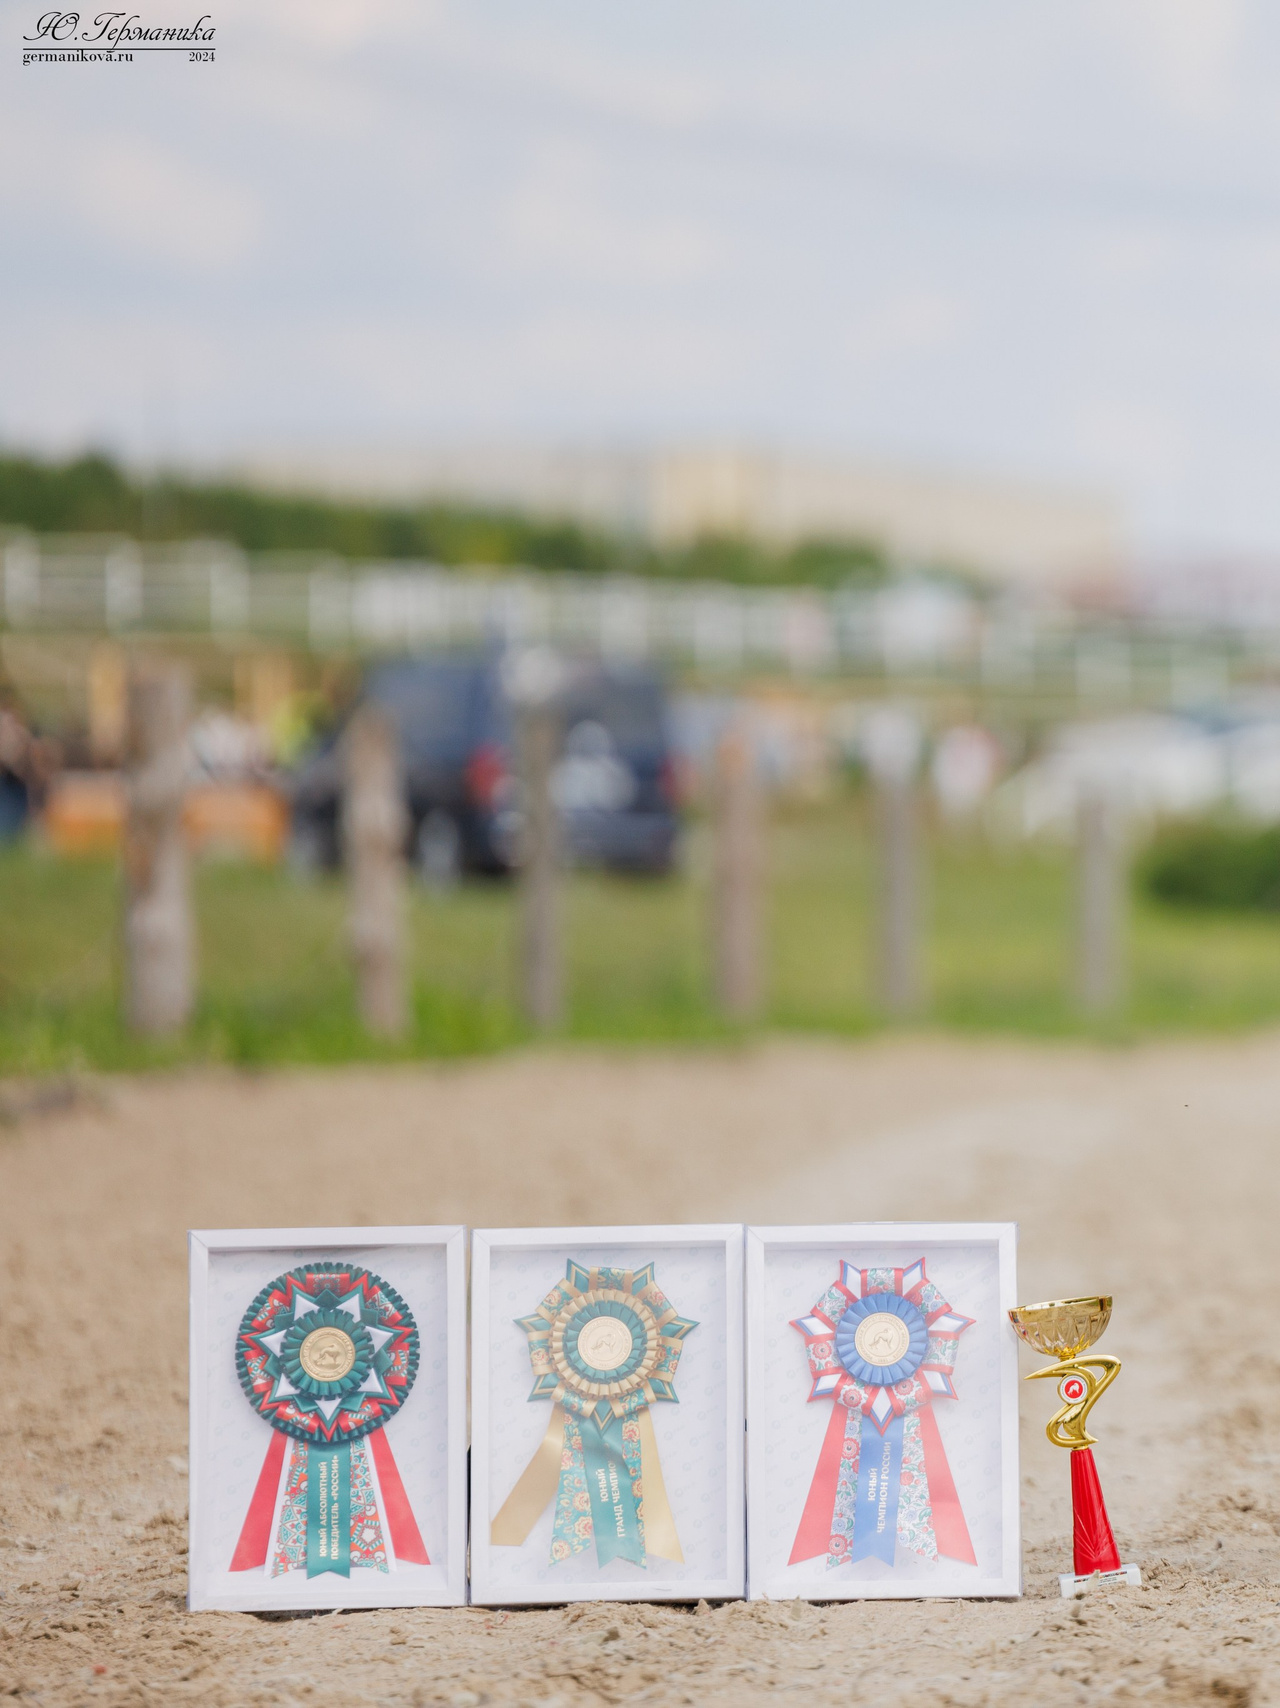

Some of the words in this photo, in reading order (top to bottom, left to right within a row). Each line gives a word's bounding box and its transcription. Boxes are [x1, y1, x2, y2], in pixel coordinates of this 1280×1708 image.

[330, 1454, 340, 1501] «РОССИИ»
[607, 1460, 621, 1503] ЧЕМПИО
[881, 1441, 892, 1481] РОССИИ
[318, 1461, 328, 1526] АБСОЛЮТНЫЙ
[596, 1468, 609, 1503] ЮНЫЙ
[868, 1467, 878, 1501] ЮНЫЙ
[614, 1504, 626, 1538] ГРАНД
[876, 1481, 889, 1534] ЧЕМПИОН
[319, 1527, 327, 1557] ЮНЫЙ
[330, 1502, 340, 1561] ПОБЕДИТЕЛЬ
